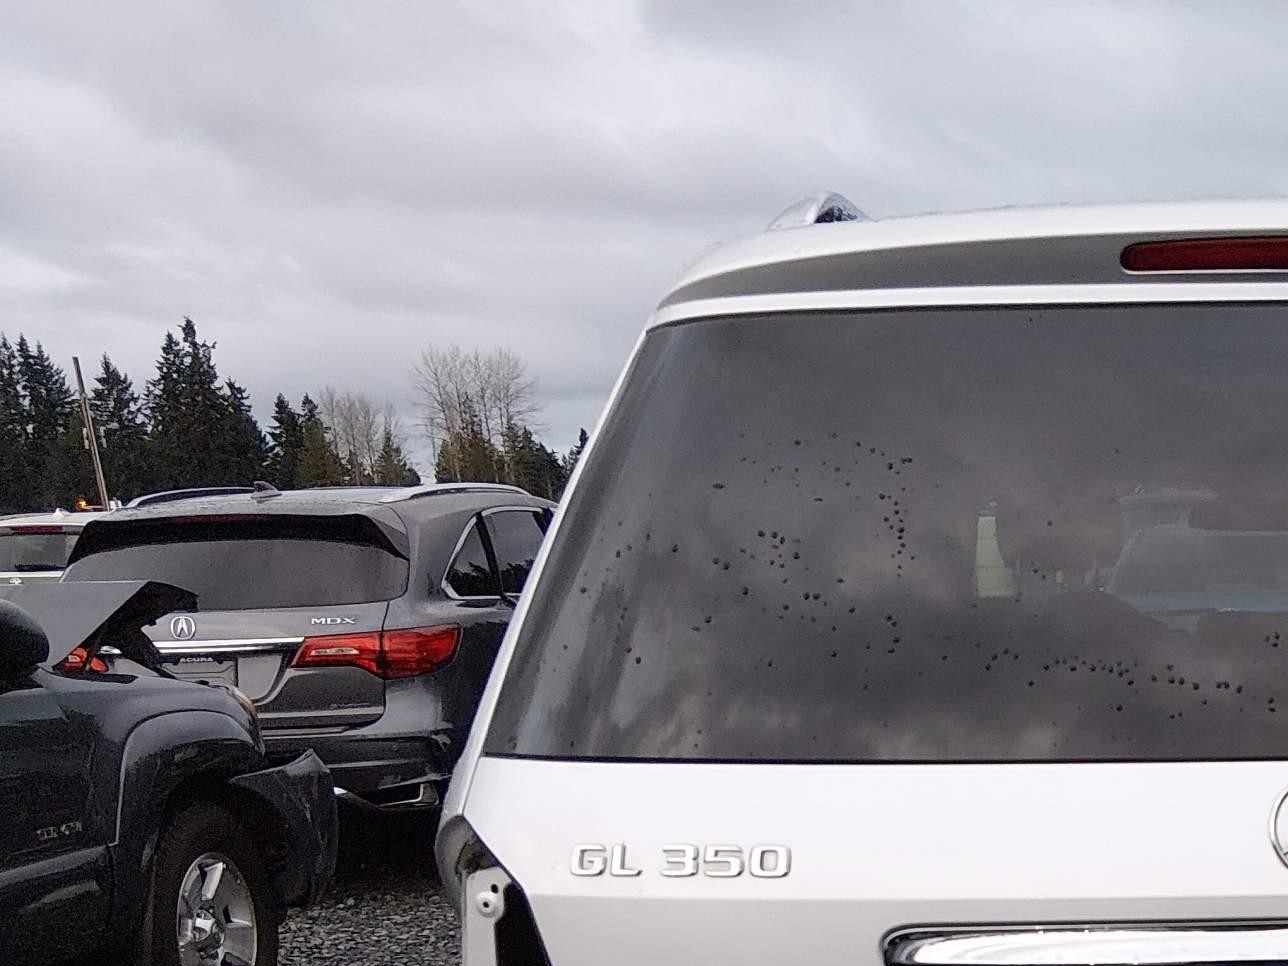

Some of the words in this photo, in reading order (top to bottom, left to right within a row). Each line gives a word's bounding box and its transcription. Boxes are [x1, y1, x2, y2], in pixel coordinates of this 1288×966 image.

[311, 617, 356, 625] MDX
[570, 842, 642, 877] GL
[659, 844, 792, 878] 350
